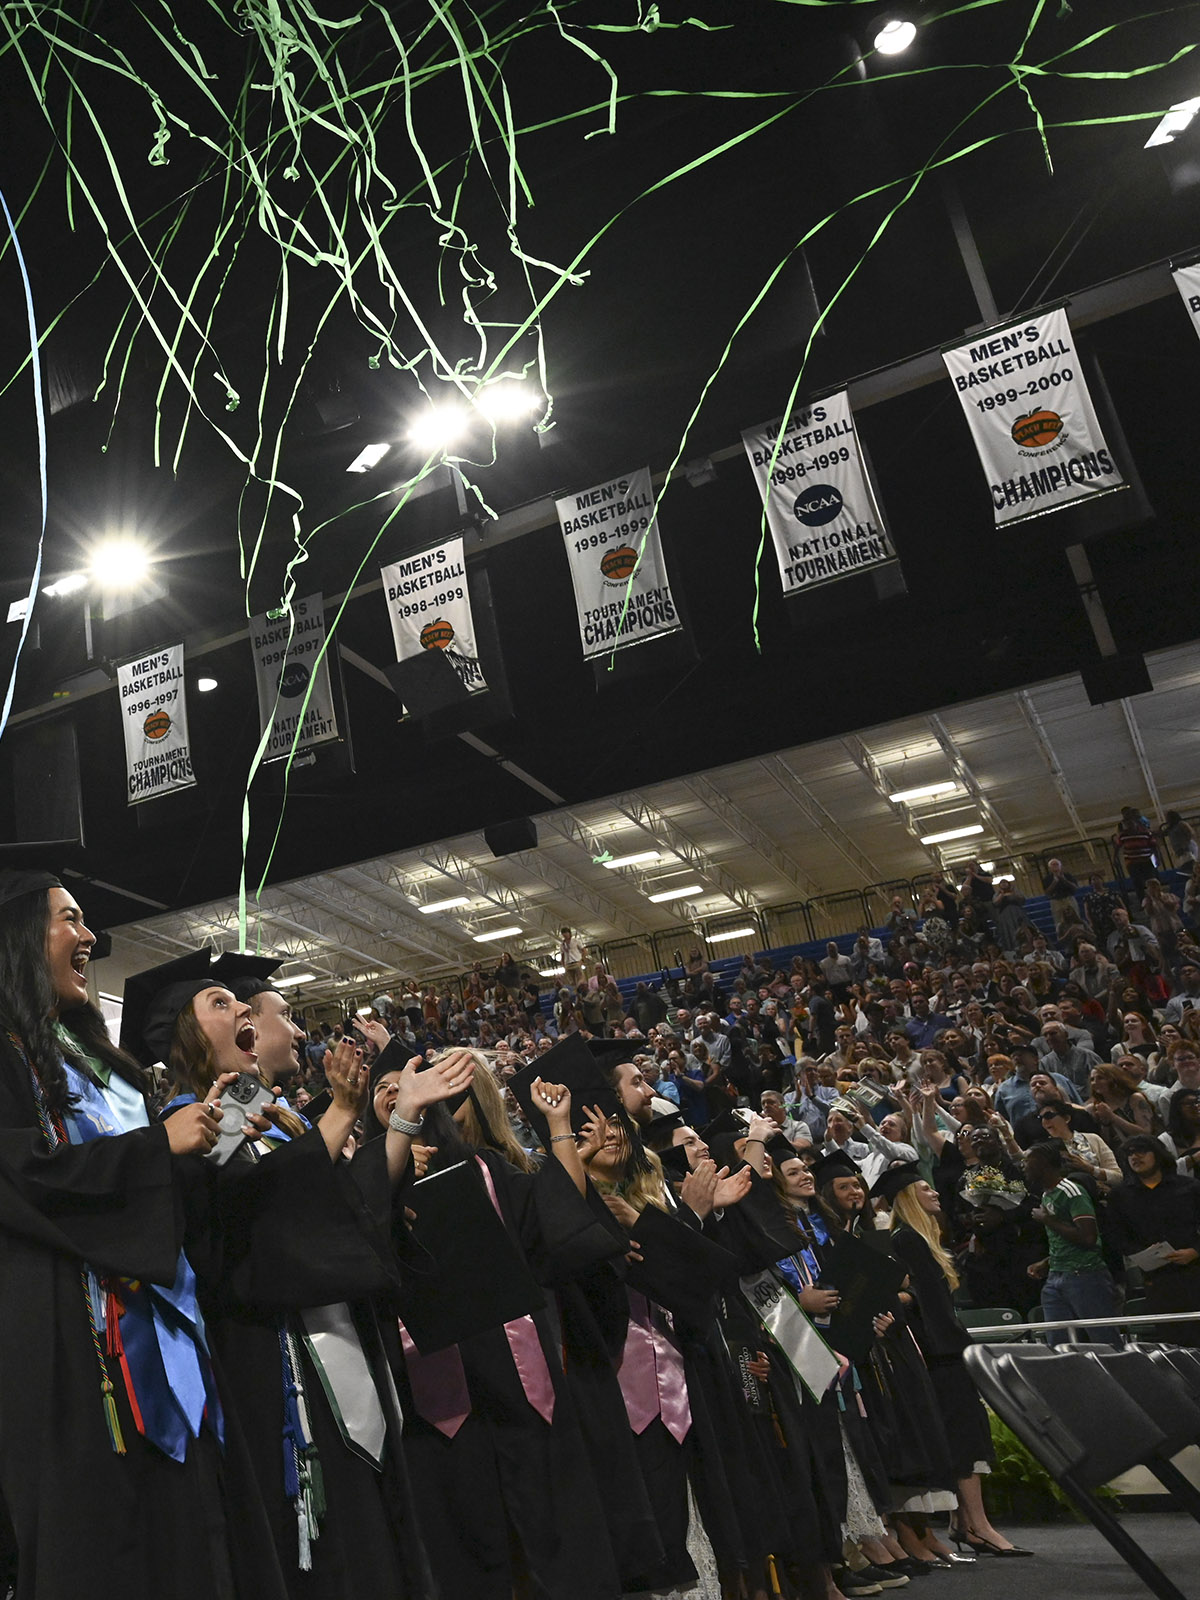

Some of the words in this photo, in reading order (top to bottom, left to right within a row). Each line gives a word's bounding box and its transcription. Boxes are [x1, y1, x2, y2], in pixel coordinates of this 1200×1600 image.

[969, 326, 1040, 363] MEN'S
[955, 338, 1071, 392] BASKETBALL
[976, 368, 1074, 413] 1999-2000
[765, 407, 827, 440] MEN'S
[752, 419, 853, 467] BASKETBALL
[770, 447, 850, 486] 1998-1999
[991, 449, 1114, 510] CHAMPIONS
[576, 480, 629, 511] MEN'S
[796, 494, 841, 518] NCAA
[563, 493, 651, 536] BASKETBALL
[785, 535, 890, 586] TOURNAMENT
[788, 522, 878, 562] NATIONAL
[388, 563, 464, 601] BASKETBALL
[399, 549, 447, 578] MEN'S
[398, 587, 463, 619] 1998-1999
[584, 586, 669, 625] TOURNAMENT
[583, 600, 676, 646] CHAMPIONS
[122, 666, 183, 698] BASKETBALL
[131, 653, 170, 677] MEN'S
[127, 689, 179, 716] 1996-1997
[129, 757, 193, 794] CHAMPIONS
[133, 746, 188, 772] TOURNAMENT
